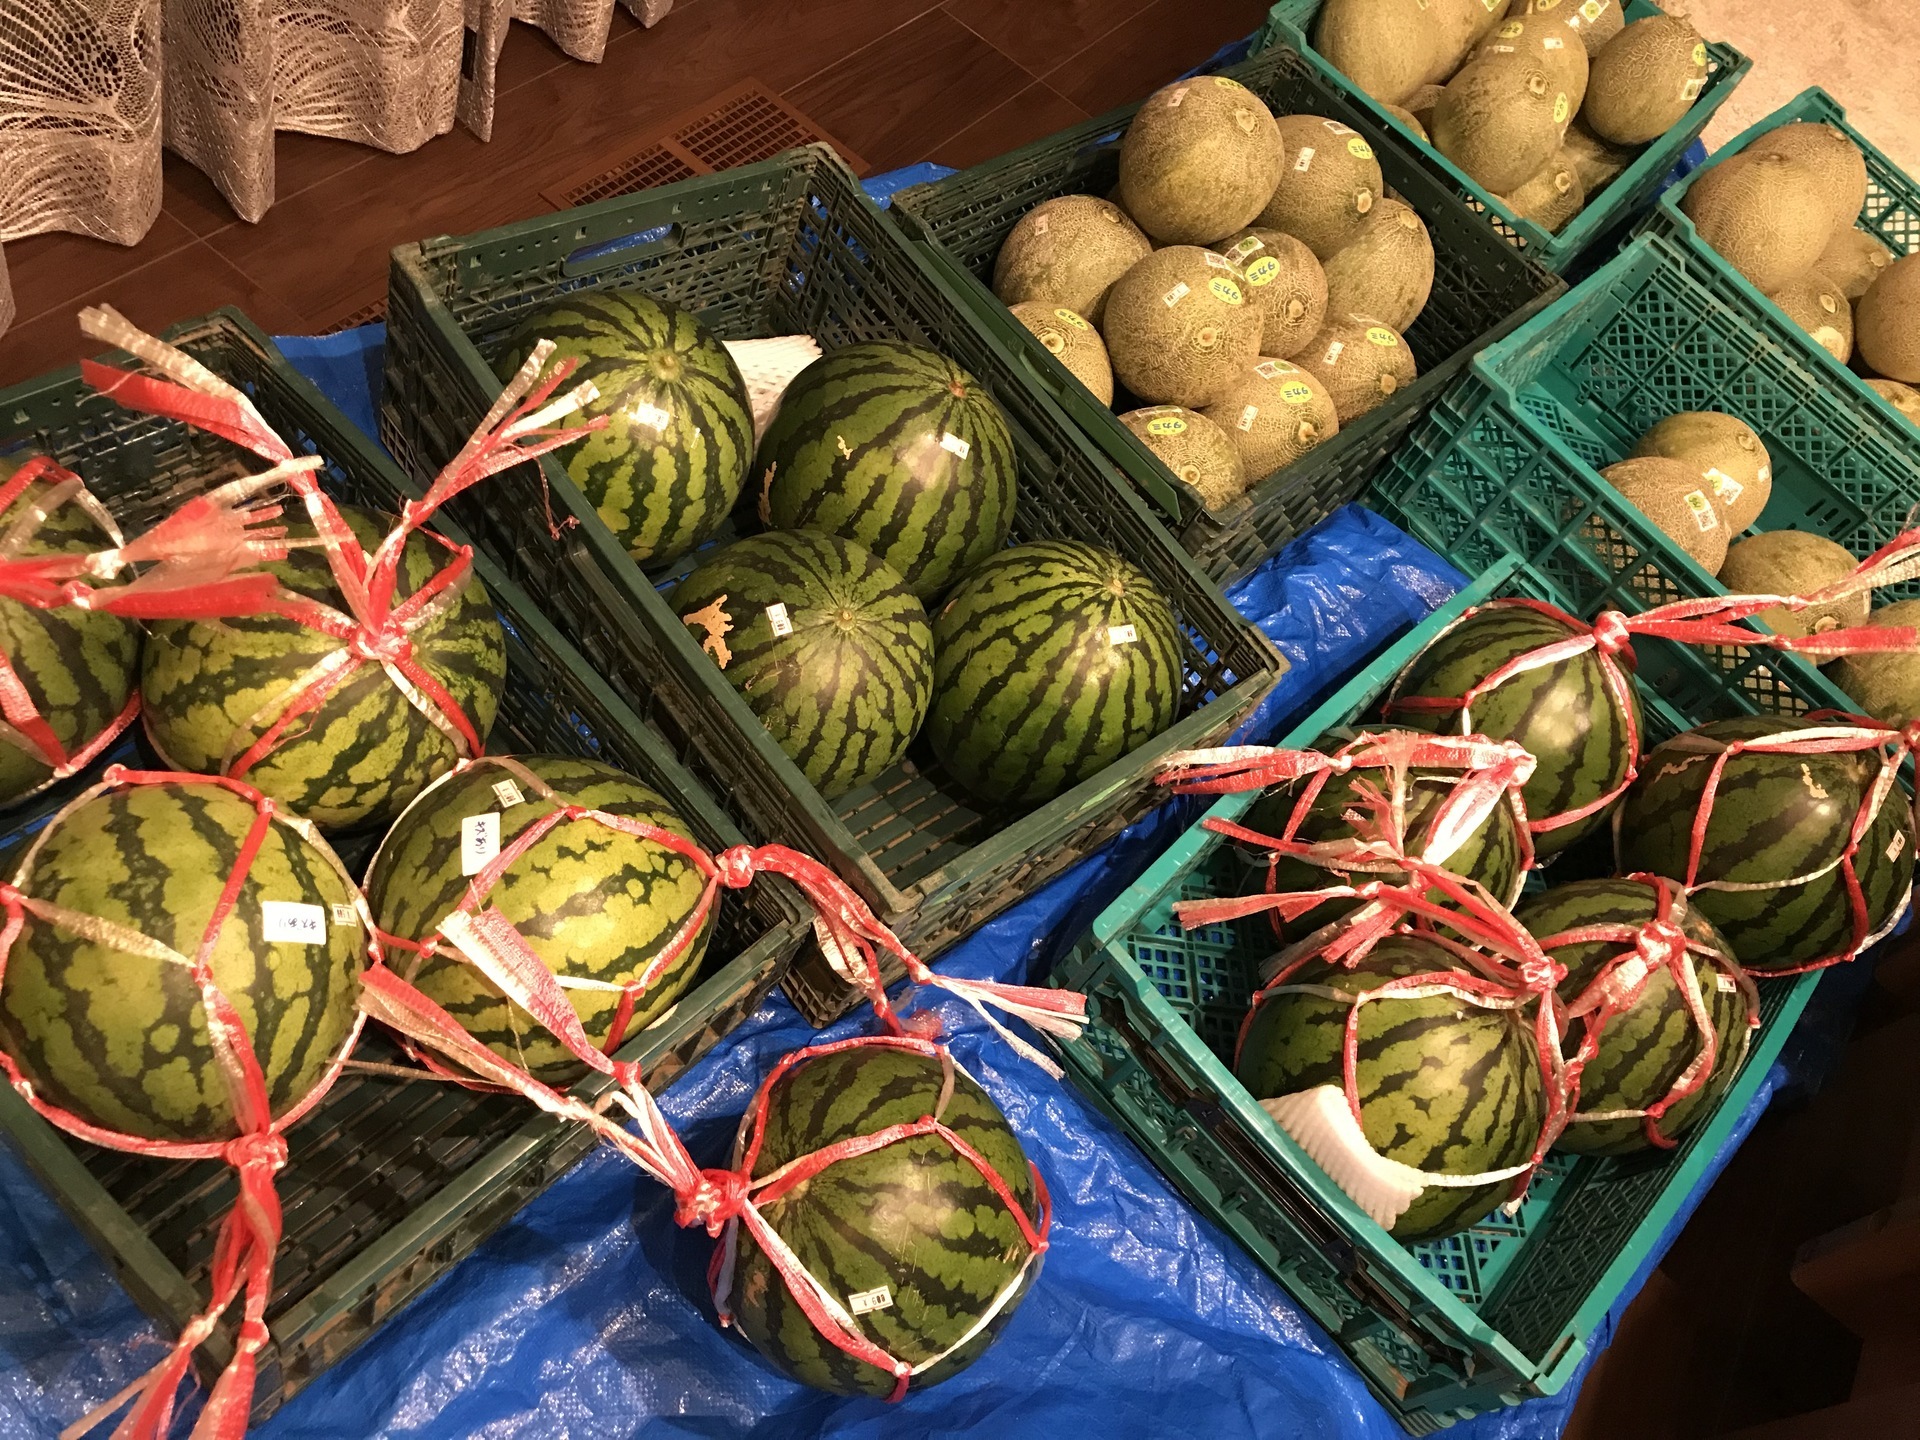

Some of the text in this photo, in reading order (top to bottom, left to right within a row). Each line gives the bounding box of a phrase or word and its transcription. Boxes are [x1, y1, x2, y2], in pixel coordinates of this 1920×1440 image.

[1249, 261, 1276, 282] タカミ
[1213, 282, 1239, 300] タカミ
[1283, 387, 1309, 399] タカミ
[1153, 421, 1182, 430] タカミ
[474, 820, 488, 855] キズあり
[278, 917, 317, 931] キズあり
